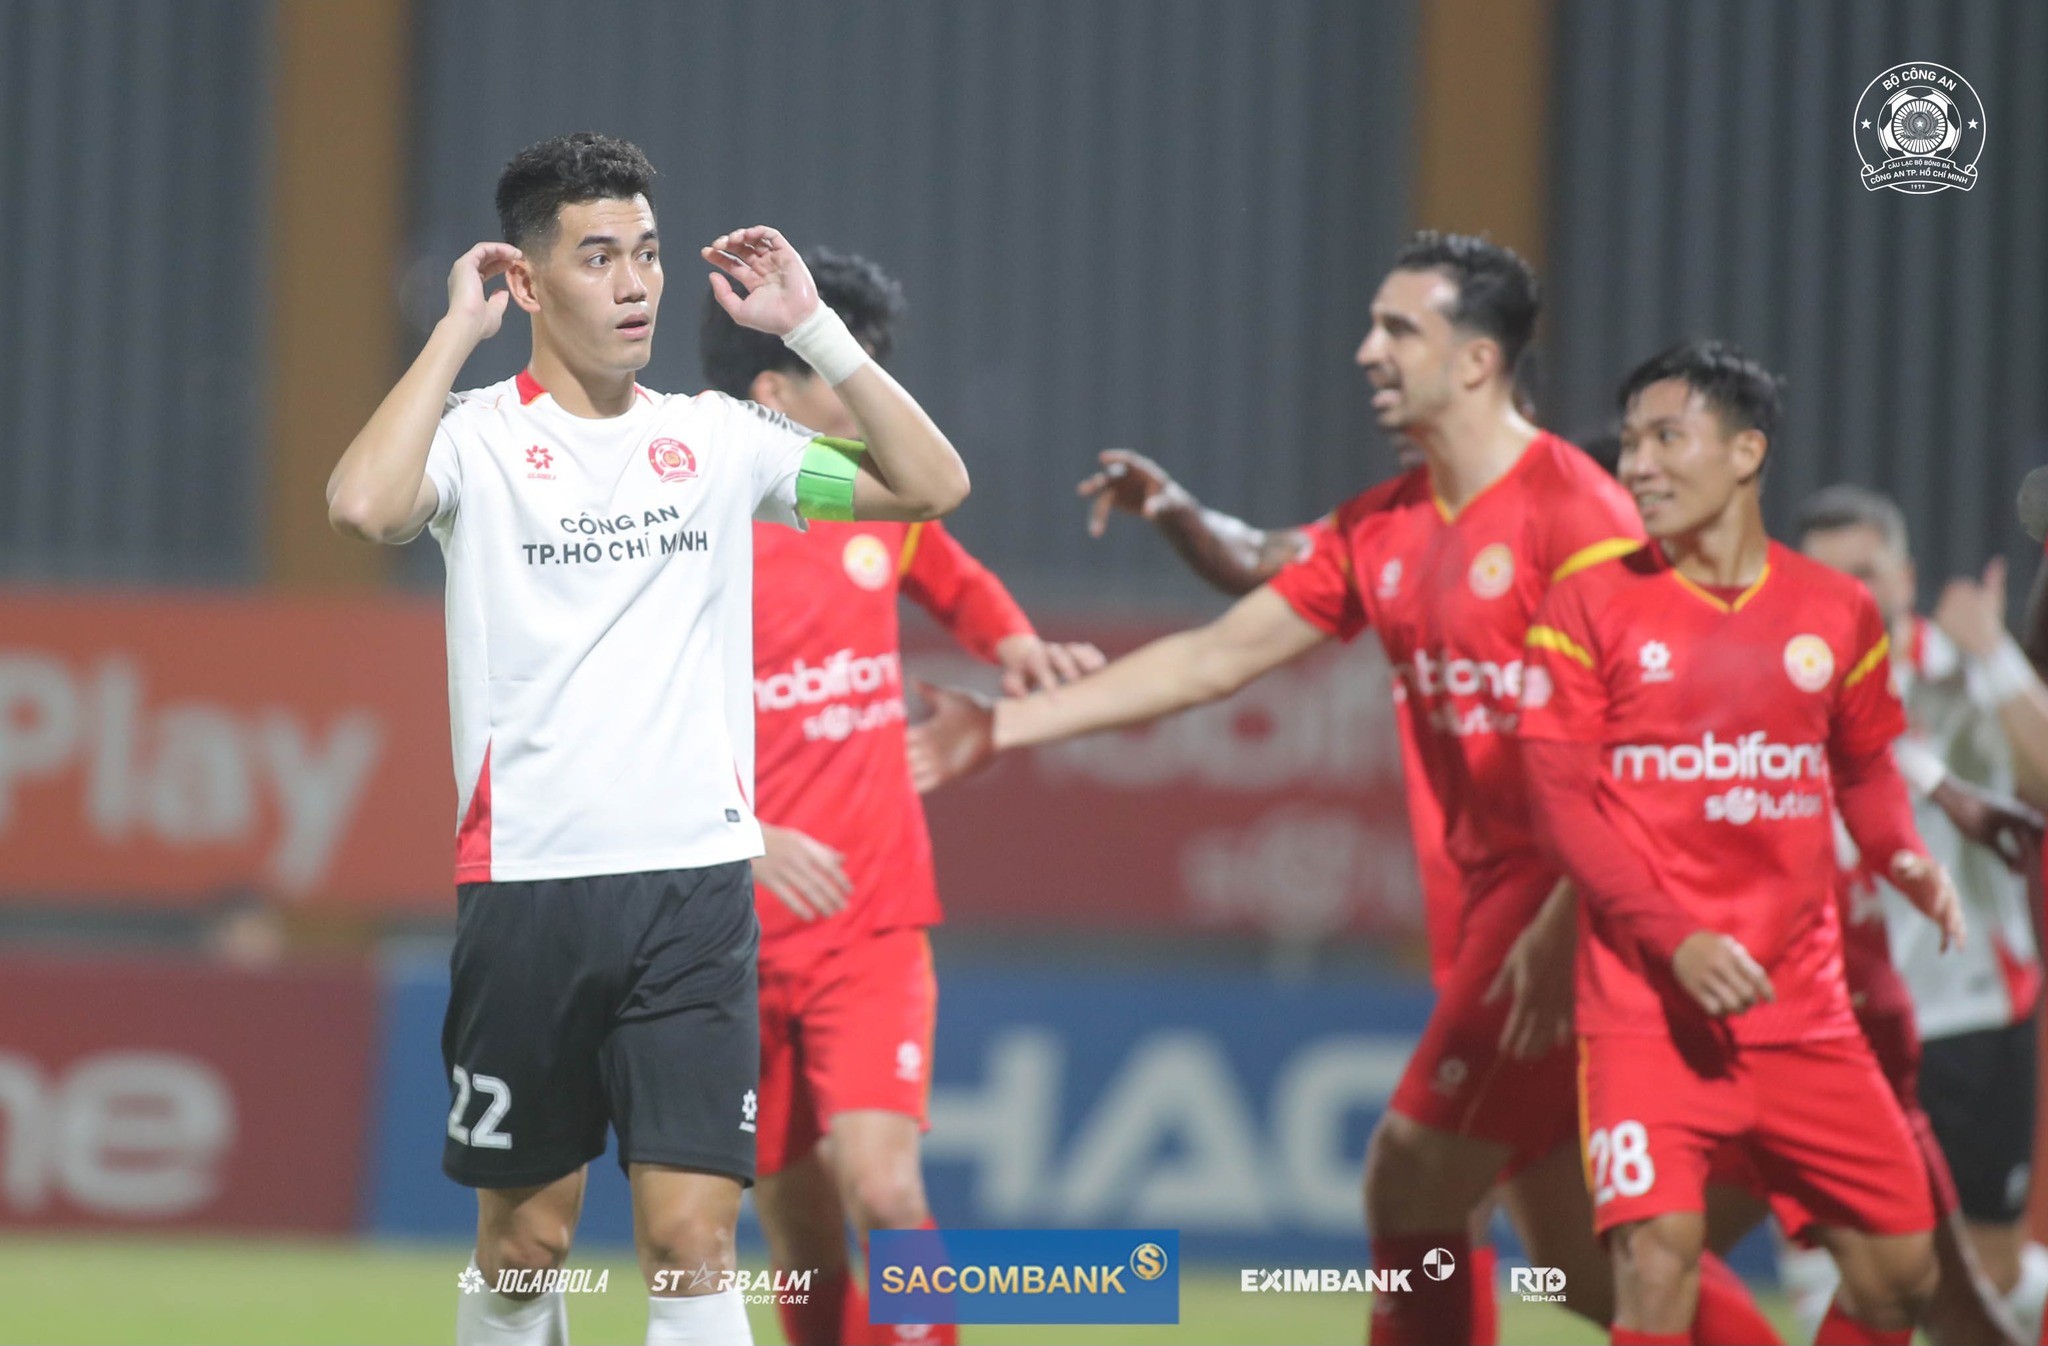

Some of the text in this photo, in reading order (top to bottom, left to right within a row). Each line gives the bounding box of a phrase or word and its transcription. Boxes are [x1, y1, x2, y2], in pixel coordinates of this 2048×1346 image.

[559, 505, 680, 535] CÔNG AN
[0, 648, 382, 890] Play
[447, 1063, 513, 1150] 22
[1588, 1119, 1656, 1206] 28
